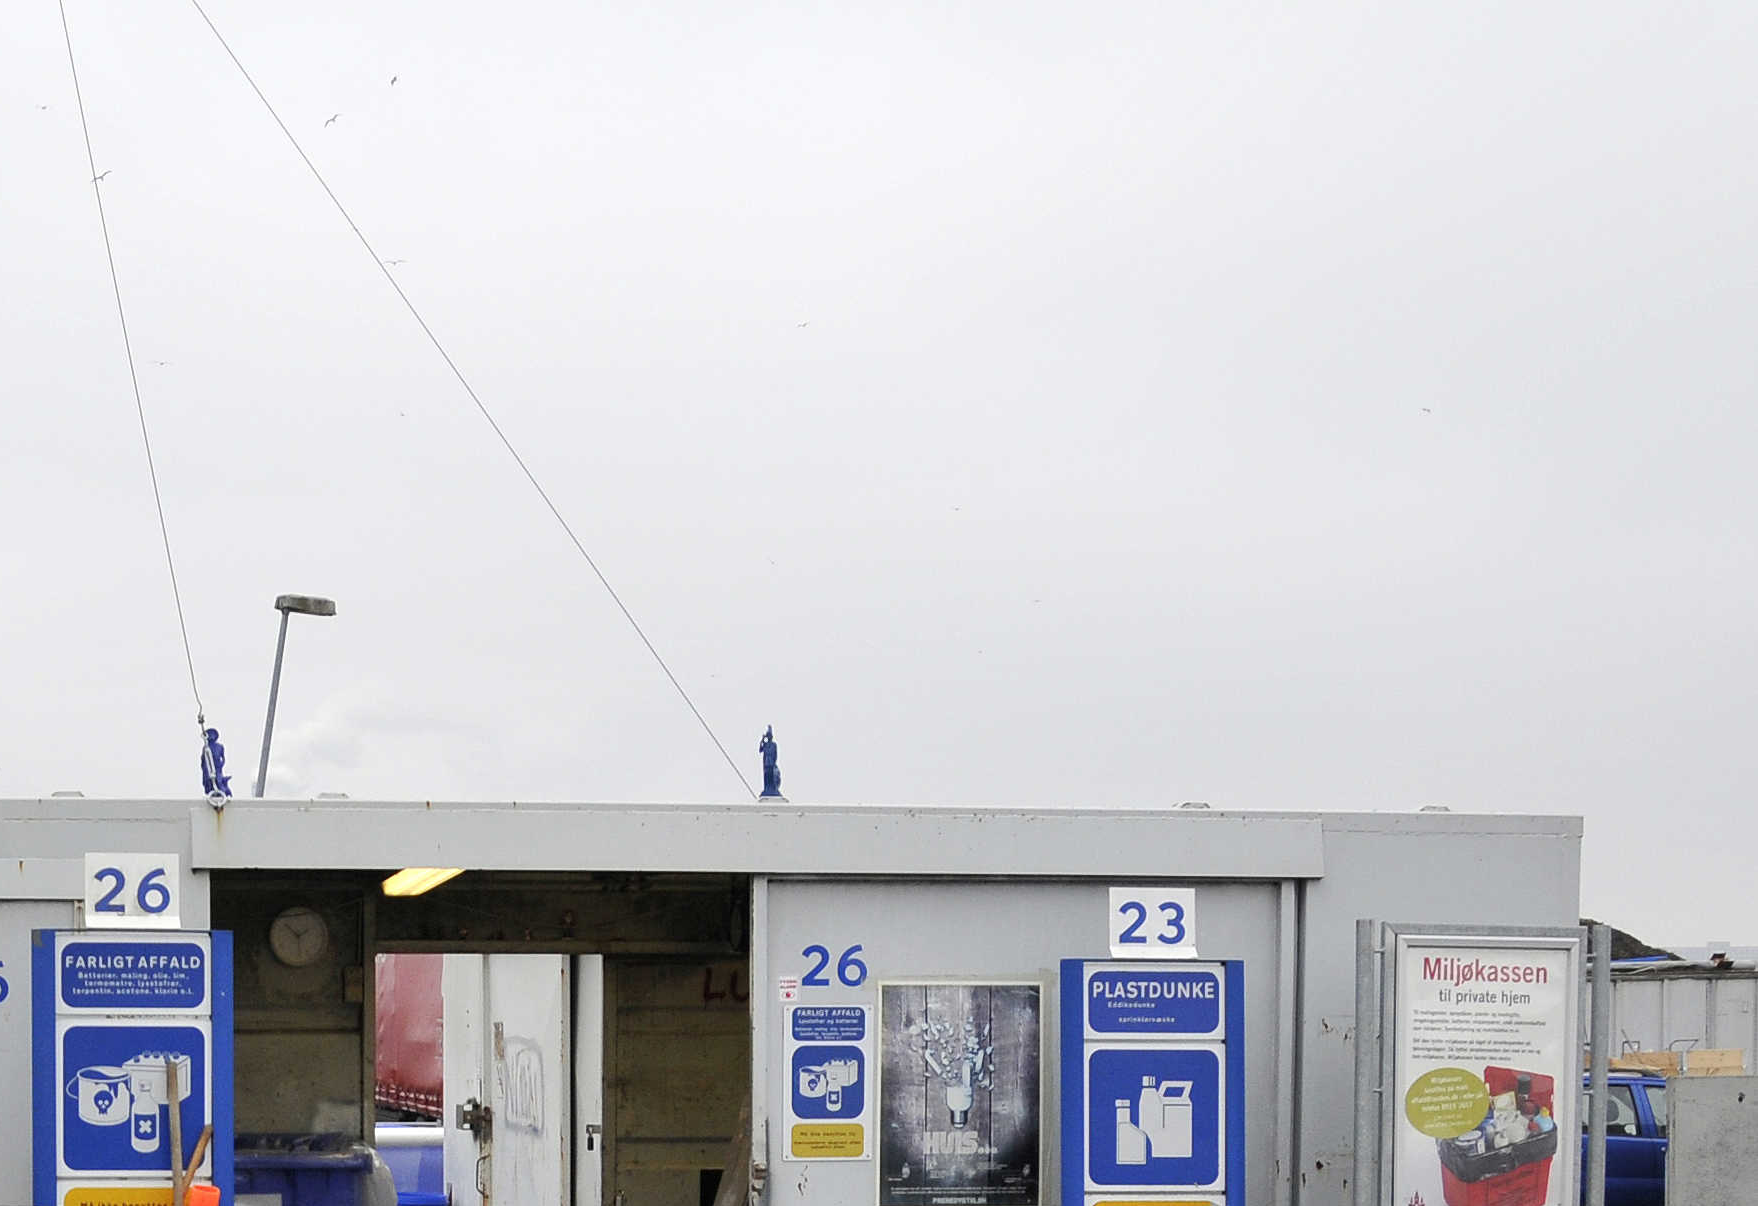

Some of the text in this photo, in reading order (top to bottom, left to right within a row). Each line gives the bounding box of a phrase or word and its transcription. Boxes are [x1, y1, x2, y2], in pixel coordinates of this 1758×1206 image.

[94, 867, 171, 915] 26
[1118, 901, 1187, 945] 23
[65, 955, 202, 969] FARLIGT AFFALD
[801, 944, 869, 988] 26
[1422, 956, 1549, 987] Miljøkassen
[1092, 981, 1216, 999] PLASTDUNKE
[1438, 988, 1532, 1007] til private hjem
[797, 1009, 862, 1017] FARLIGT AFFALD
